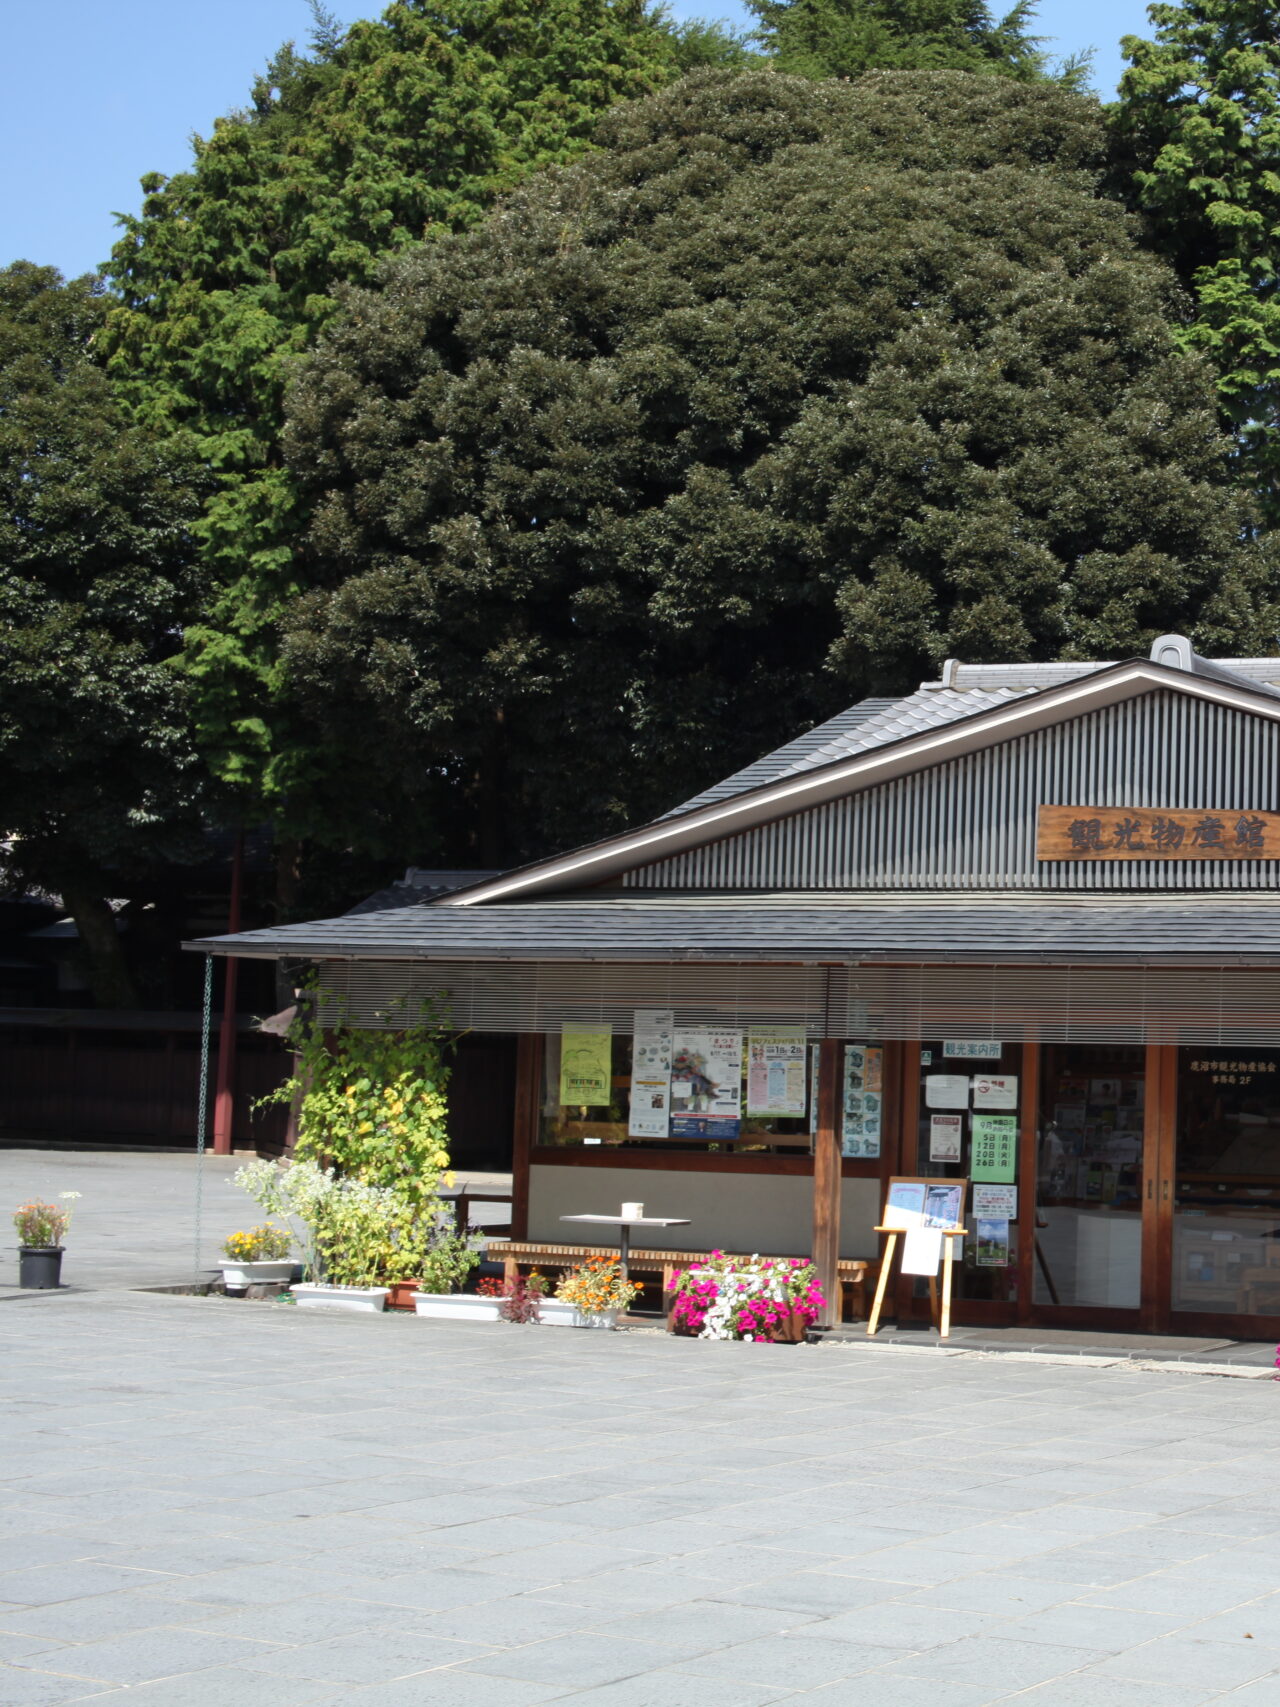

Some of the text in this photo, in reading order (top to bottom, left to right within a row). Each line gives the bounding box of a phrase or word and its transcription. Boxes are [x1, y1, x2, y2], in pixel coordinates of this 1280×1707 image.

[1066, 815, 1268, 850] 観光物産館
[945, 1042, 999, 1057] 観光案内所
[1239, 1076, 1252, 1085] 2F
